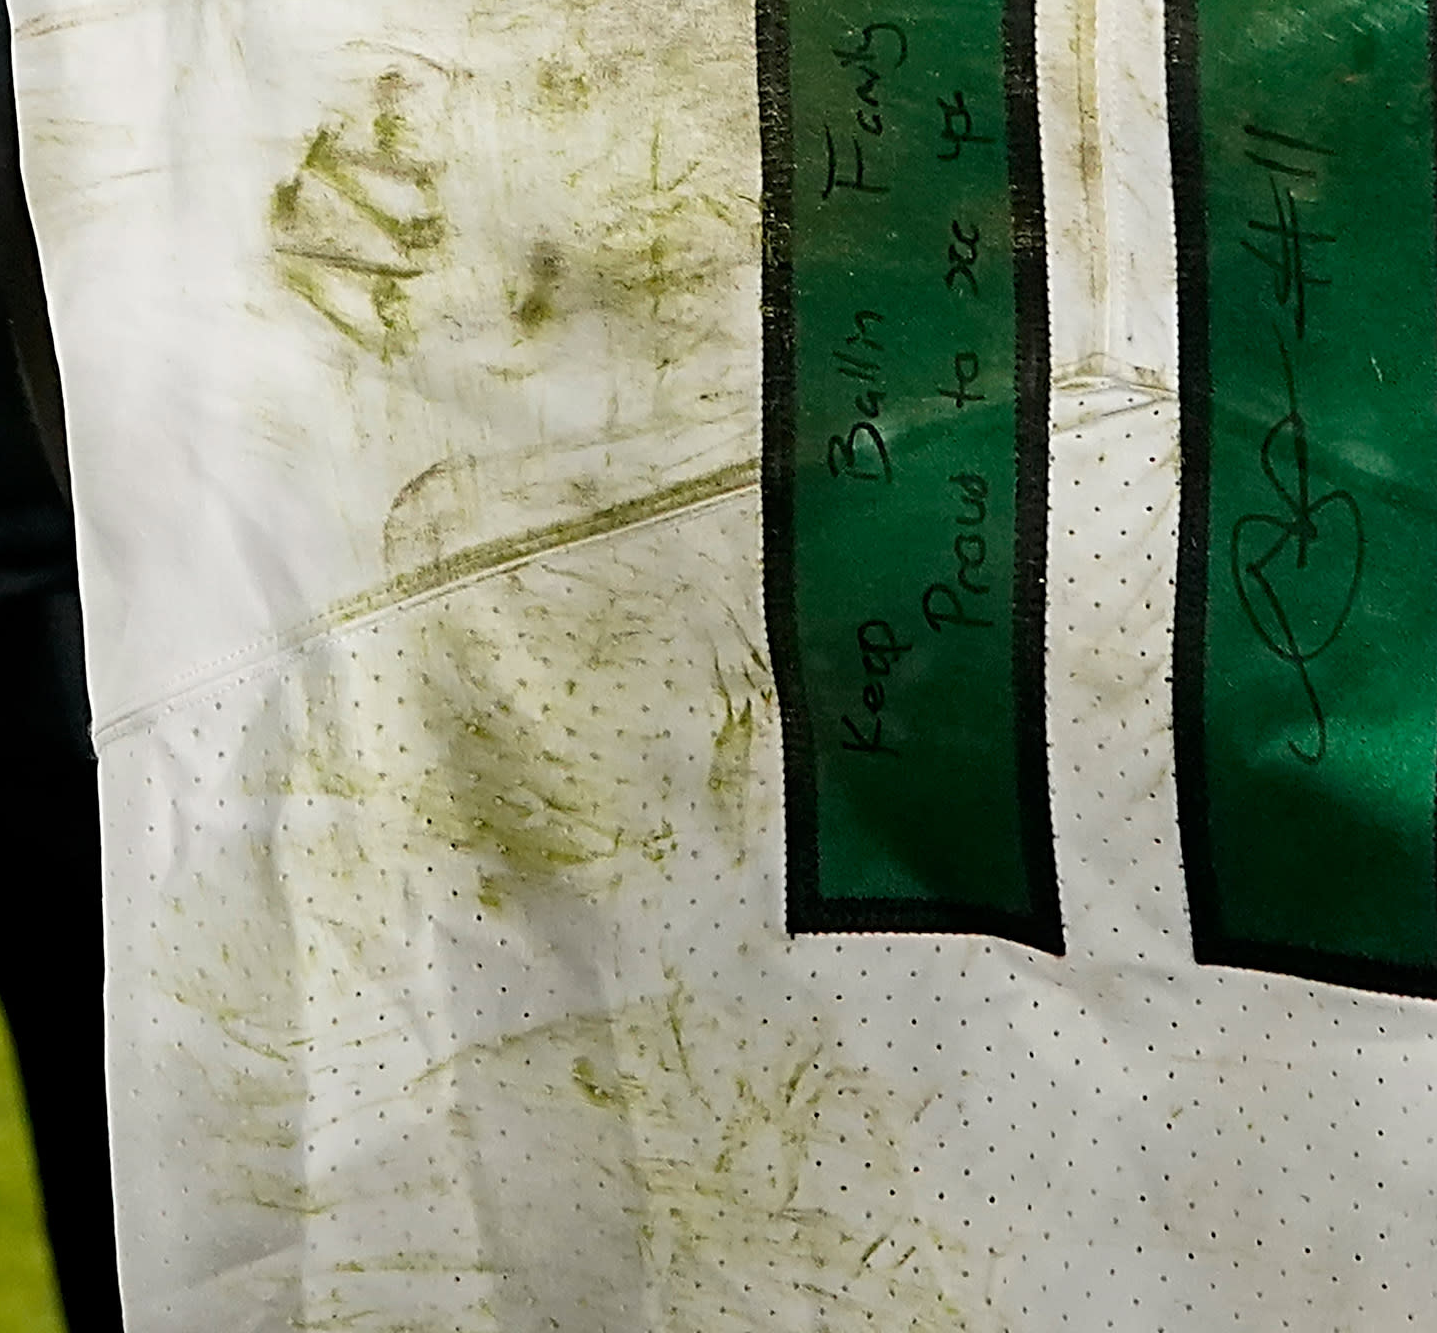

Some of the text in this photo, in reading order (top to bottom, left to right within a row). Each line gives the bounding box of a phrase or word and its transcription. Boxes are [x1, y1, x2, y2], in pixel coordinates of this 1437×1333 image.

[937, 350, 988, 406] to
[923, 470, 993, 635] Proud
[841, 618, 911, 756] Keep
